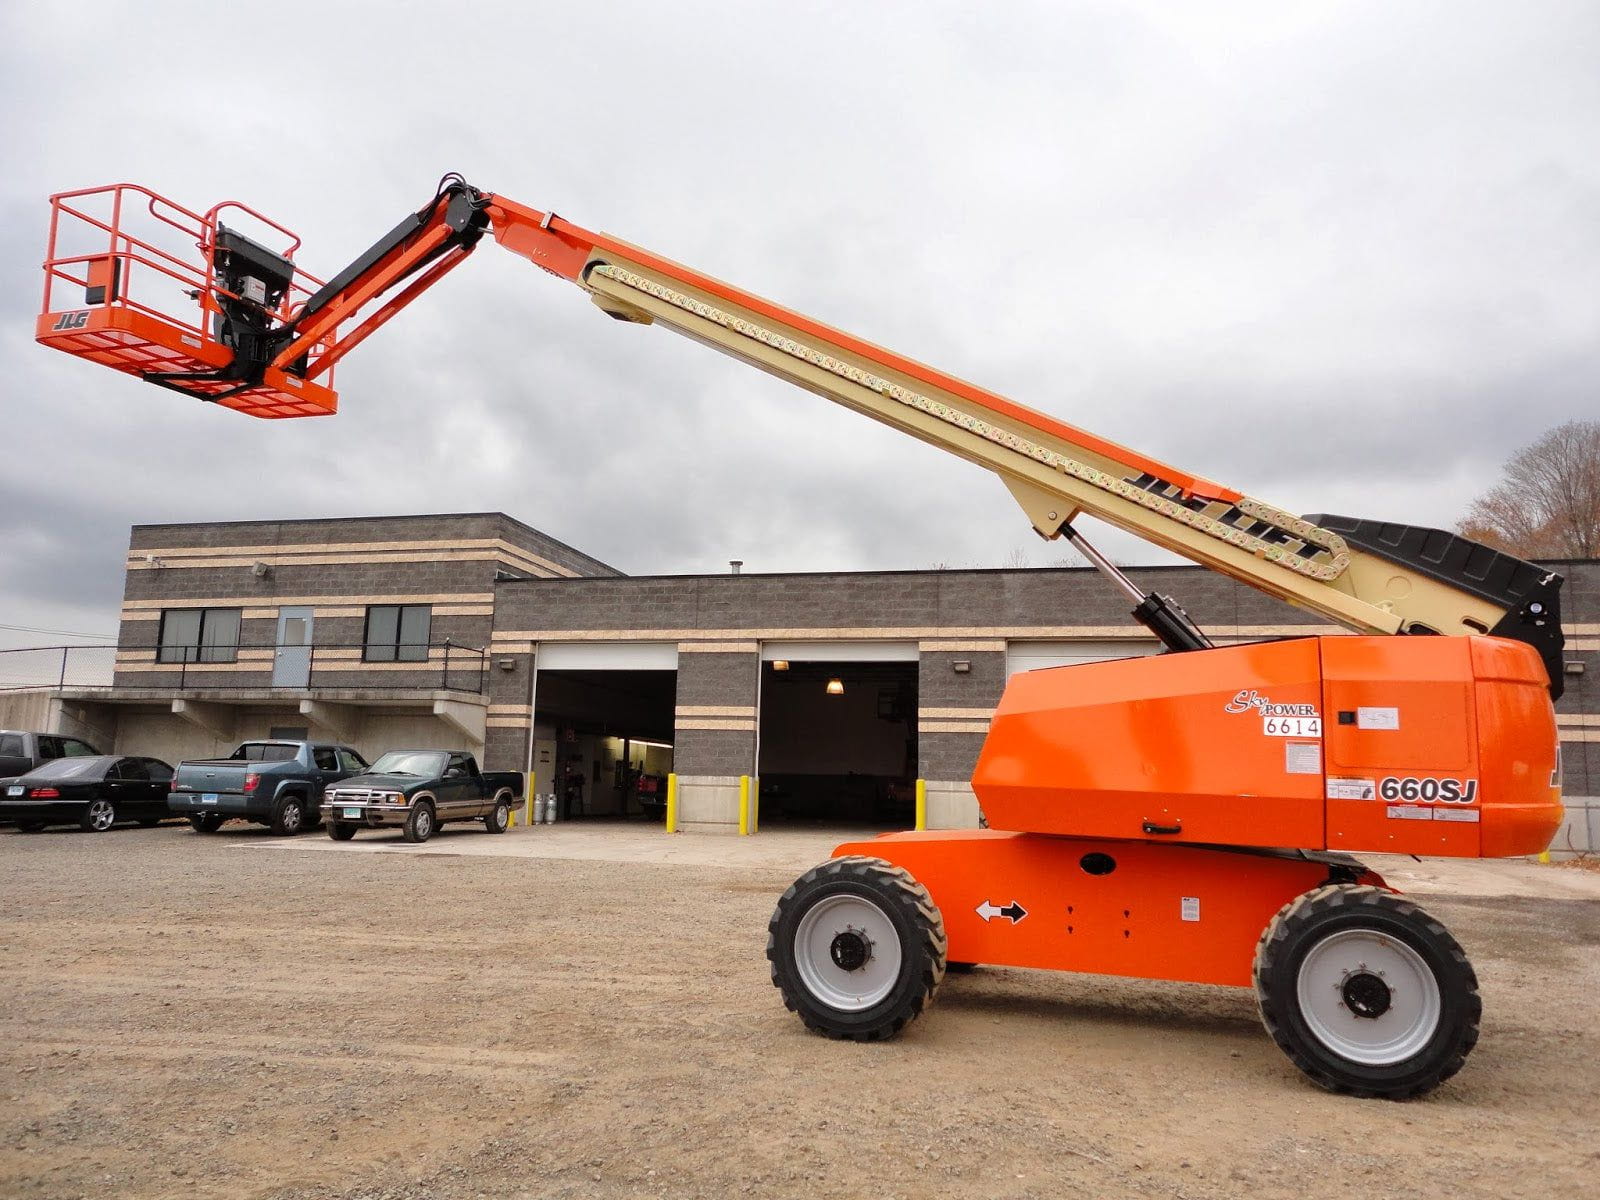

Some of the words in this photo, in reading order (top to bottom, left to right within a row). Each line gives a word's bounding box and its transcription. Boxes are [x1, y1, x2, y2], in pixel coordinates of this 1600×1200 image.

[52, 311, 91, 331] JLG
[1225, 690, 1269, 716] Sky
[1264, 704, 1316, 716] POWER
[1266, 719, 1319, 735] 6614
[1380, 777, 1477, 803] 660SJ
